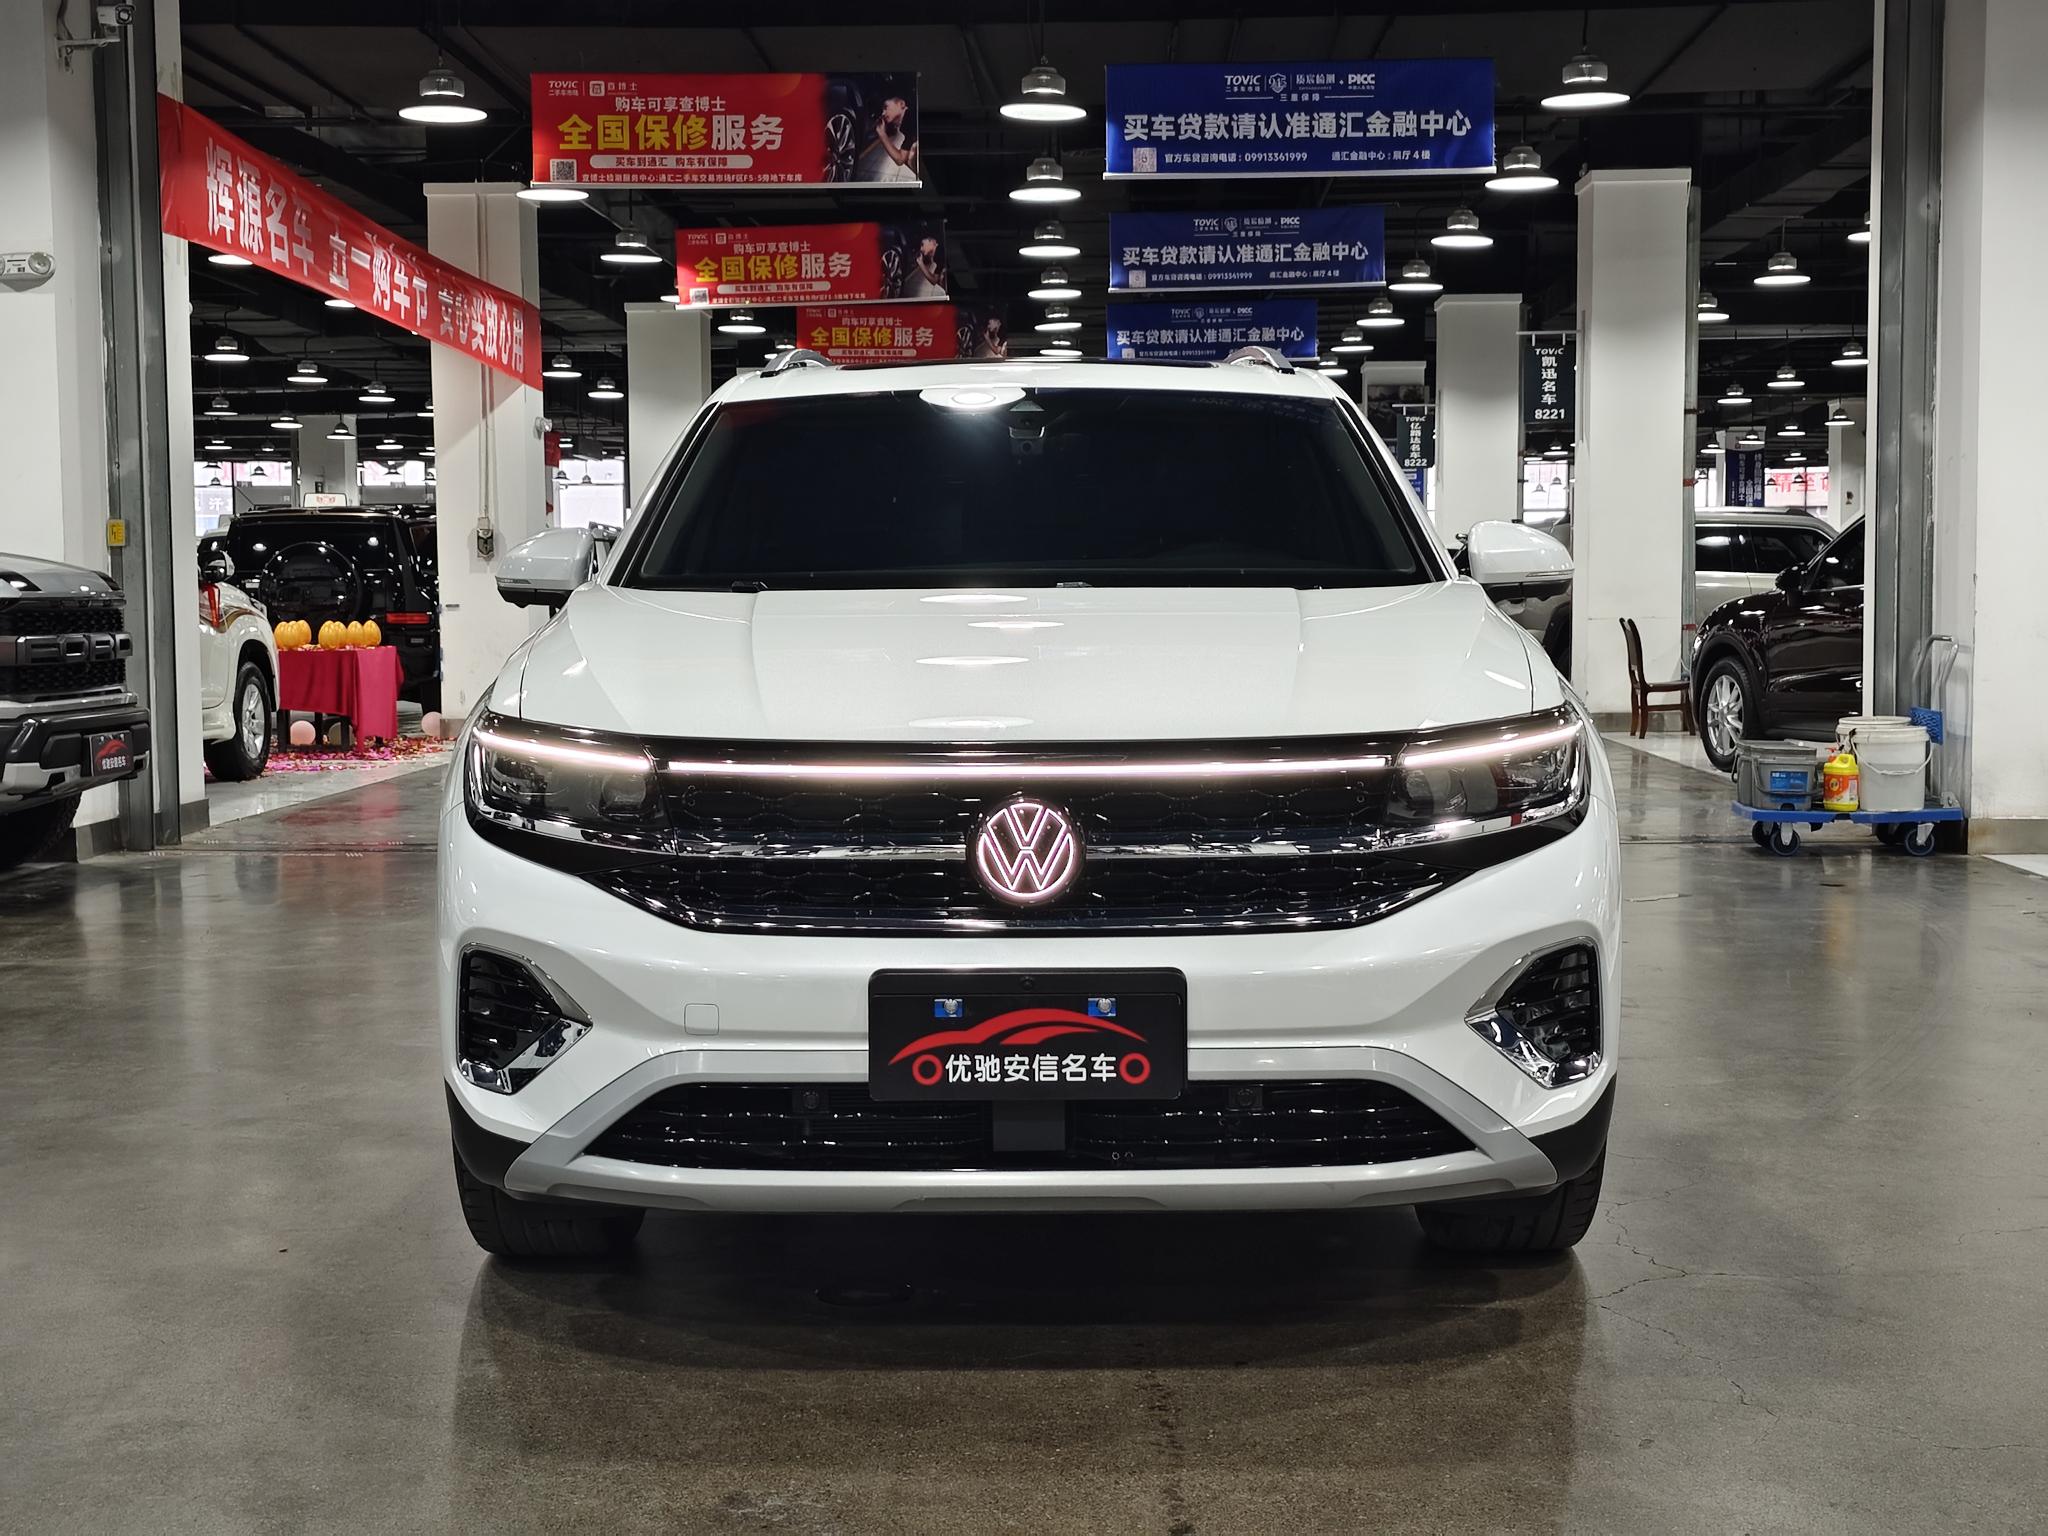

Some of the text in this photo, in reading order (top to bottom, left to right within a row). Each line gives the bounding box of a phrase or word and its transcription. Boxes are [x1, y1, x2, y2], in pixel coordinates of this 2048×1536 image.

[548, 80, 579, 89] TOVIC
[1224, 74, 1262, 86] TOVIC
[1347, 73, 1376, 85] PICC
[614, 96, 726, 113] 购车可享查博士
[557, 113, 785, 151] 全国保修服务
[1123, 109, 1472, 141] 买车贷款请认准通汇金融中心
[615, 156, 728, 168] 买车到通汇 购车有保障
[205, 136, 315, 278] 辉源名车
[733, 241, 811, 255] 购车可享查博士
[1122, 241, 1369, 267] 买车贷款请认准通汇金融中心
[694, 251, 852, 283] 全国保修服务
[810, 327, 934, 347] 全国保修服务
[1116, 327, 1305, 345] 买车贷款请认准通汇金融中心
[1534, 408, 1566, 420] 8221
[1404, 458, 1427, 467] 8222
[945, 1053, 1118, 1084] 优驰安信名车
